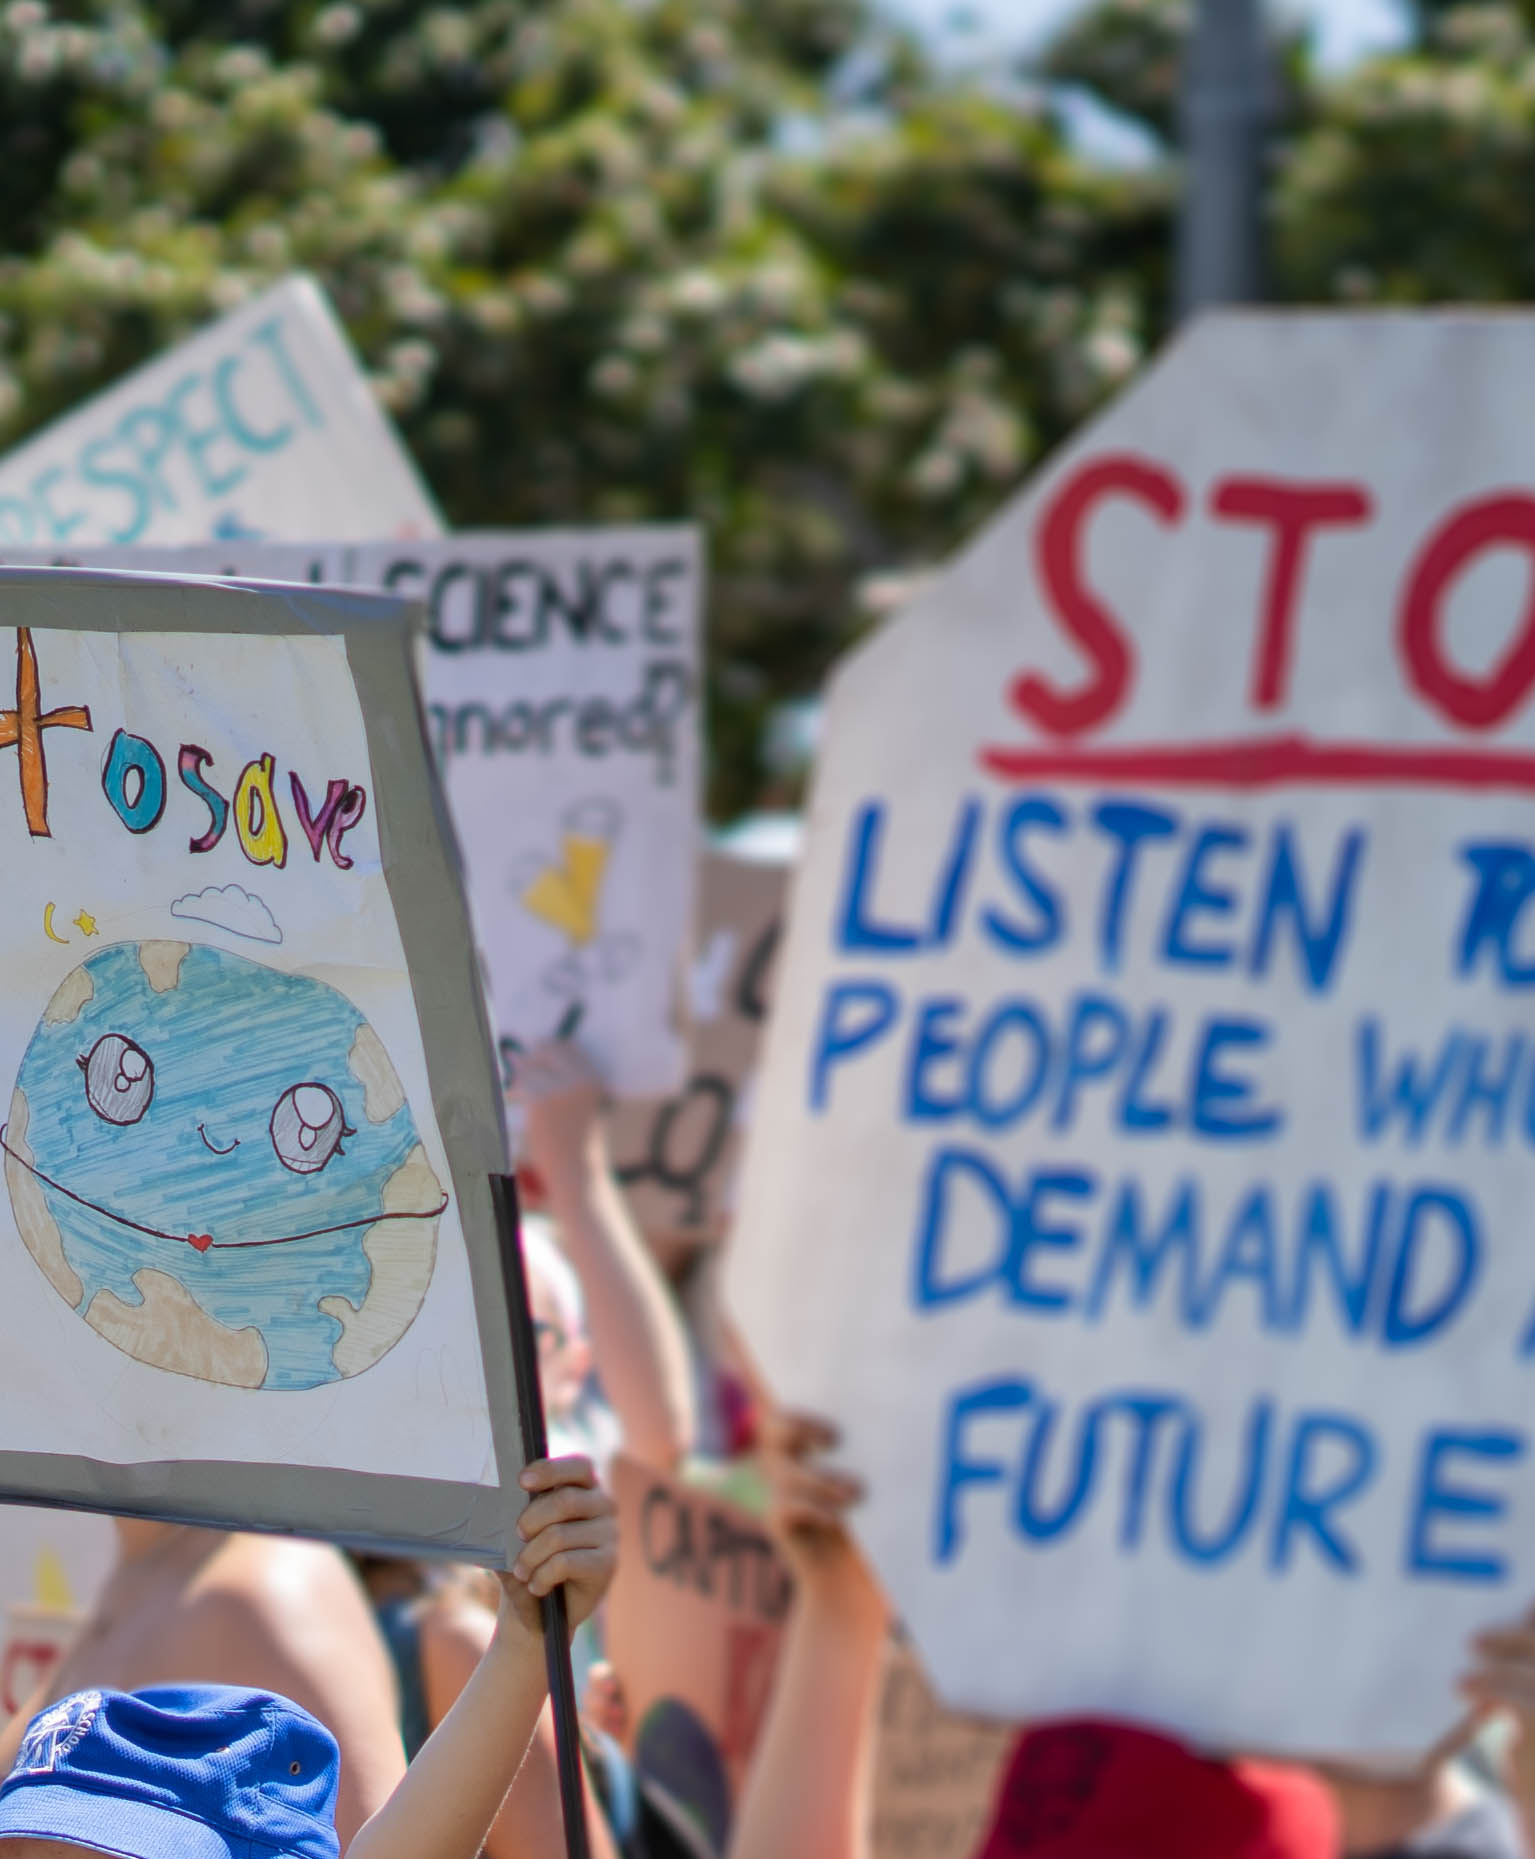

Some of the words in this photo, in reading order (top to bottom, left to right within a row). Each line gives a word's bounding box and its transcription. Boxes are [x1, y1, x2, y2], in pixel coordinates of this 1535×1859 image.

[832, 790, 1370, 998] LISTEN
[808, 976, 1285, 1142] PEOPLE
[1355, 1012, 1535, 1152] WH
[911, 1142, 1483, 1355] DEMAND
[932, 1374, 1529, 1590] FUTURE
